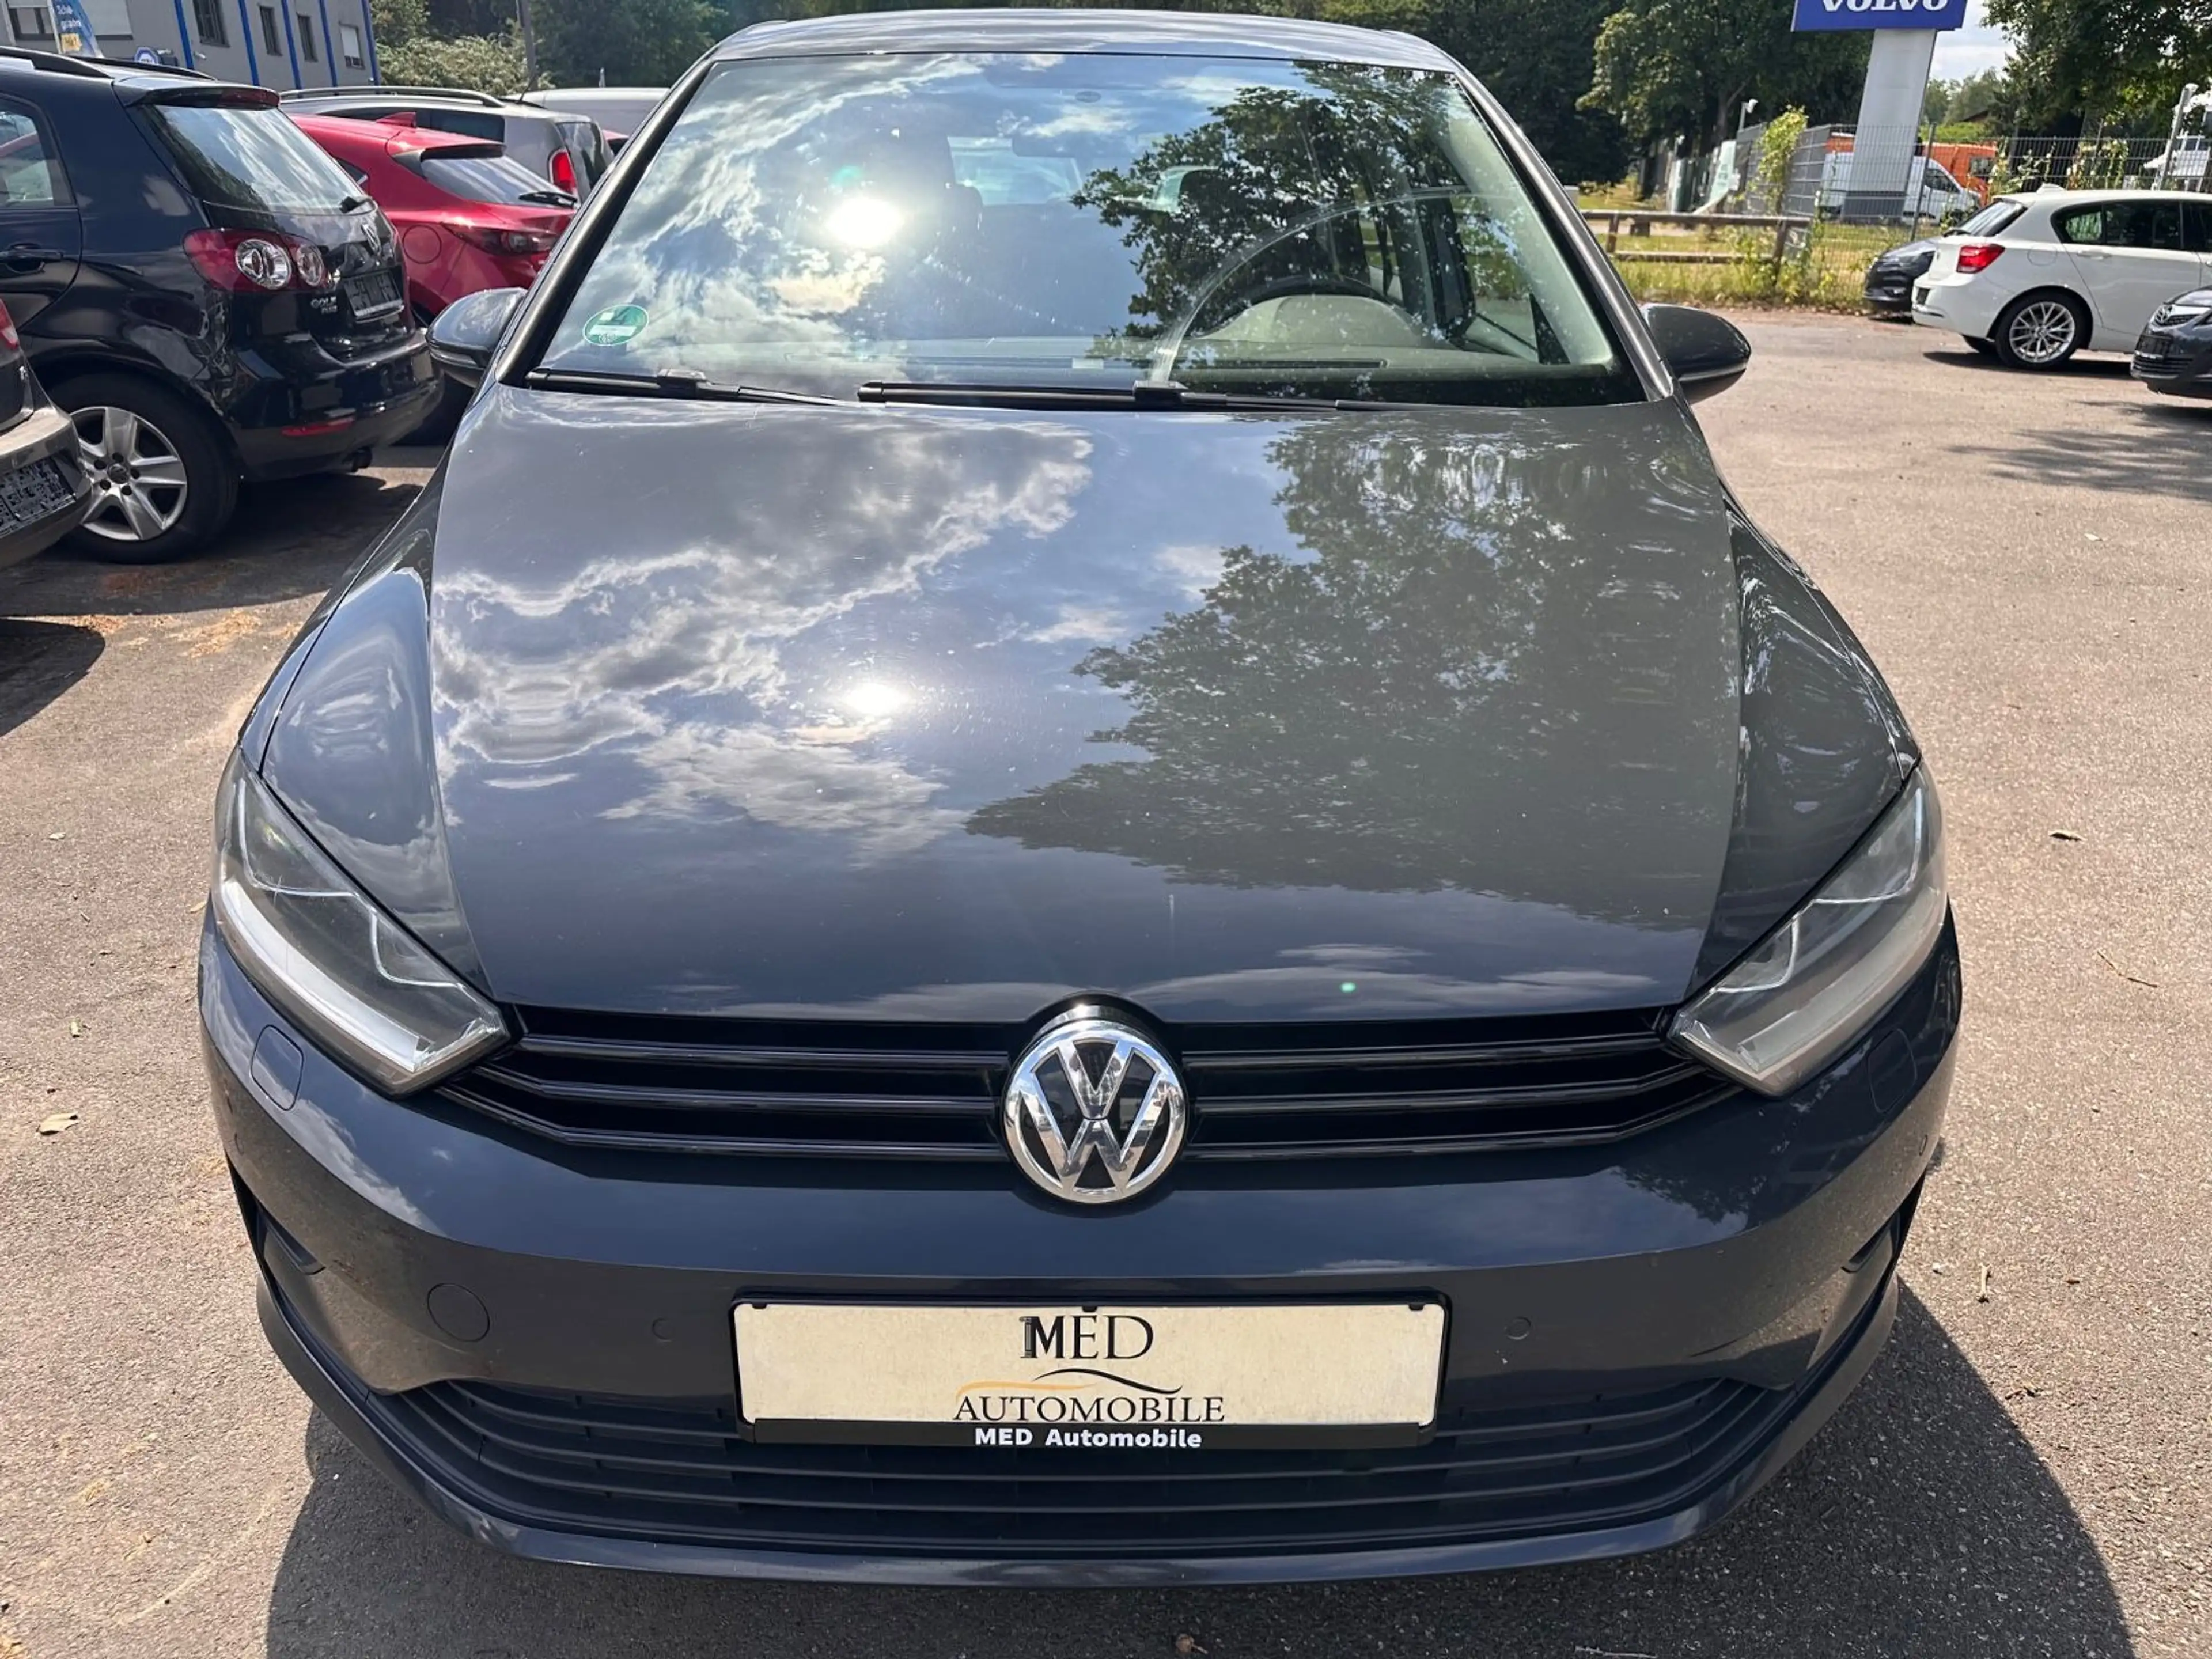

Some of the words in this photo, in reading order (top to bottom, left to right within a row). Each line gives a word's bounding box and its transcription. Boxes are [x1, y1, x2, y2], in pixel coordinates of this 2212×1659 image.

[1823, 0, 1948, 12] VOLVO
[1019, 1315, 1154, 1359] MED
[953, 1395, 1225, 1422] AUTOMOBILE
[975, 1427, 1033, 1446] MED
[1045, 1428, 1202, 1448] Automobile
